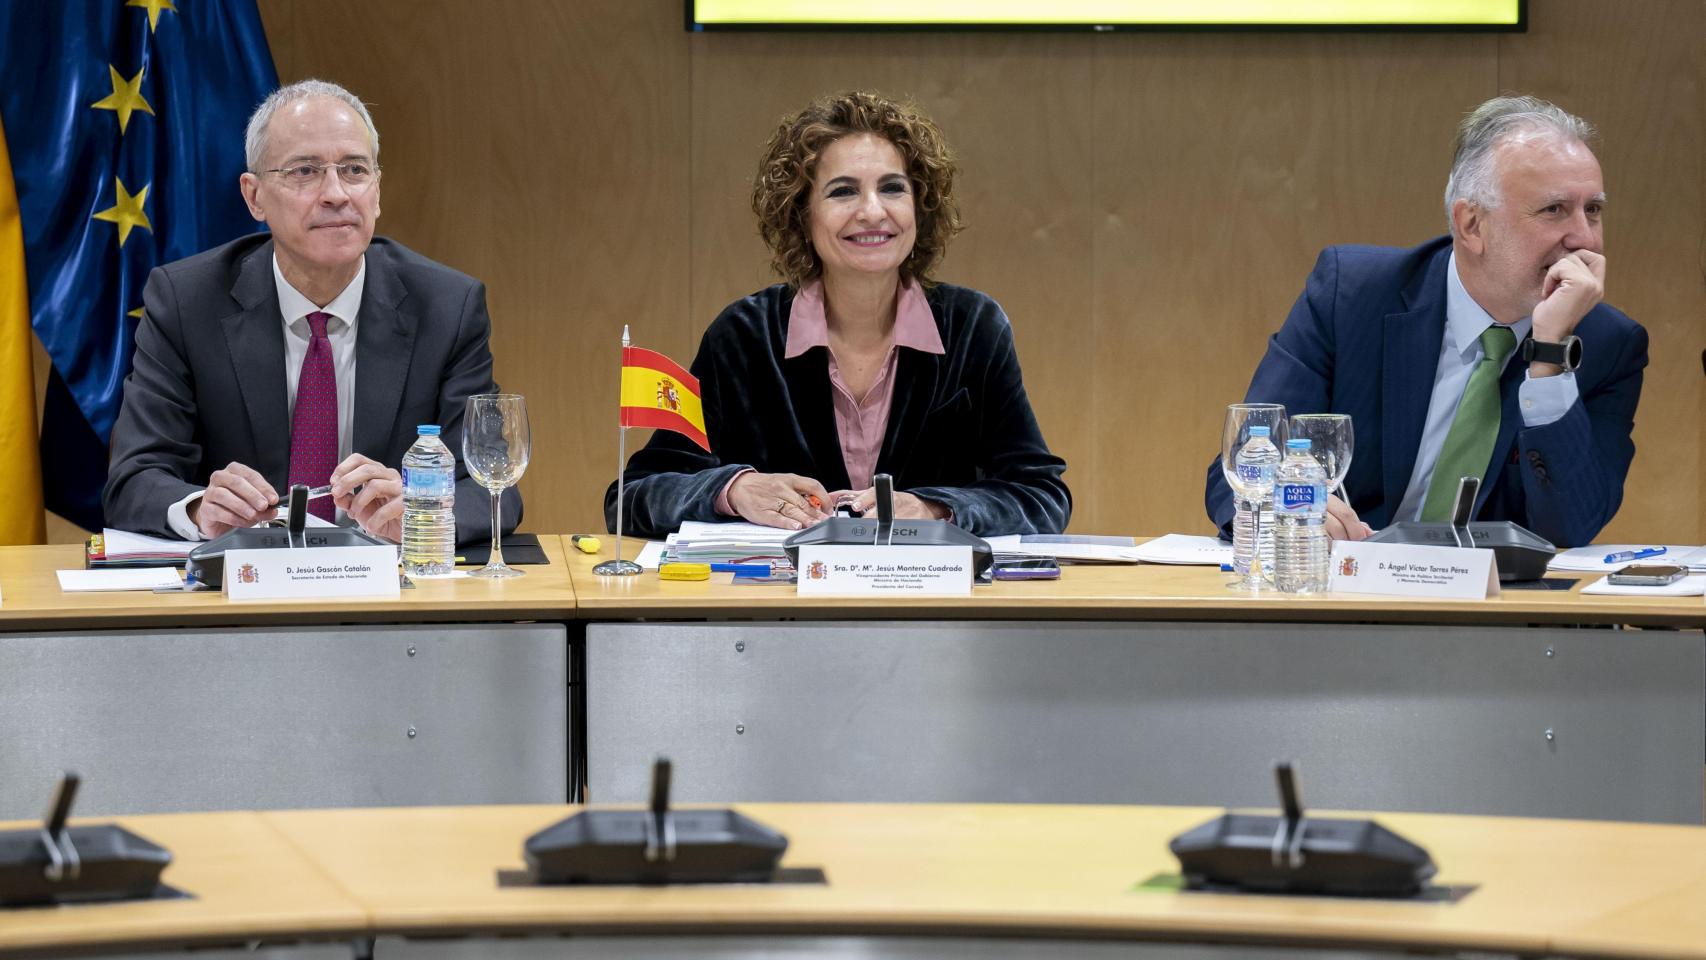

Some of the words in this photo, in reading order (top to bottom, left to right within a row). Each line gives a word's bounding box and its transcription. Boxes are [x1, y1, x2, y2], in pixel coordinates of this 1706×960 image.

[873, 528, 918, 536] SCH
[286, 566, 294, 574] D.
[296, 565, 315, 573] Jesús
[316, 564, 342, 573] Gascón
[344, 564, 371, 572] Catalán
[834, 564, 848, 572] Sra.
[876, 563, 895, 572] Jesús
[897, 564, 926, 572] Montero
[928, 564, 963, 572] Cuadrado
[1379, 562, 1386, 570] D.
[1388, 561, 1407, 572] Ángel
[1429, 565, 1449, 573] Torres
[1451, 565, 1469, 574] Pérez
